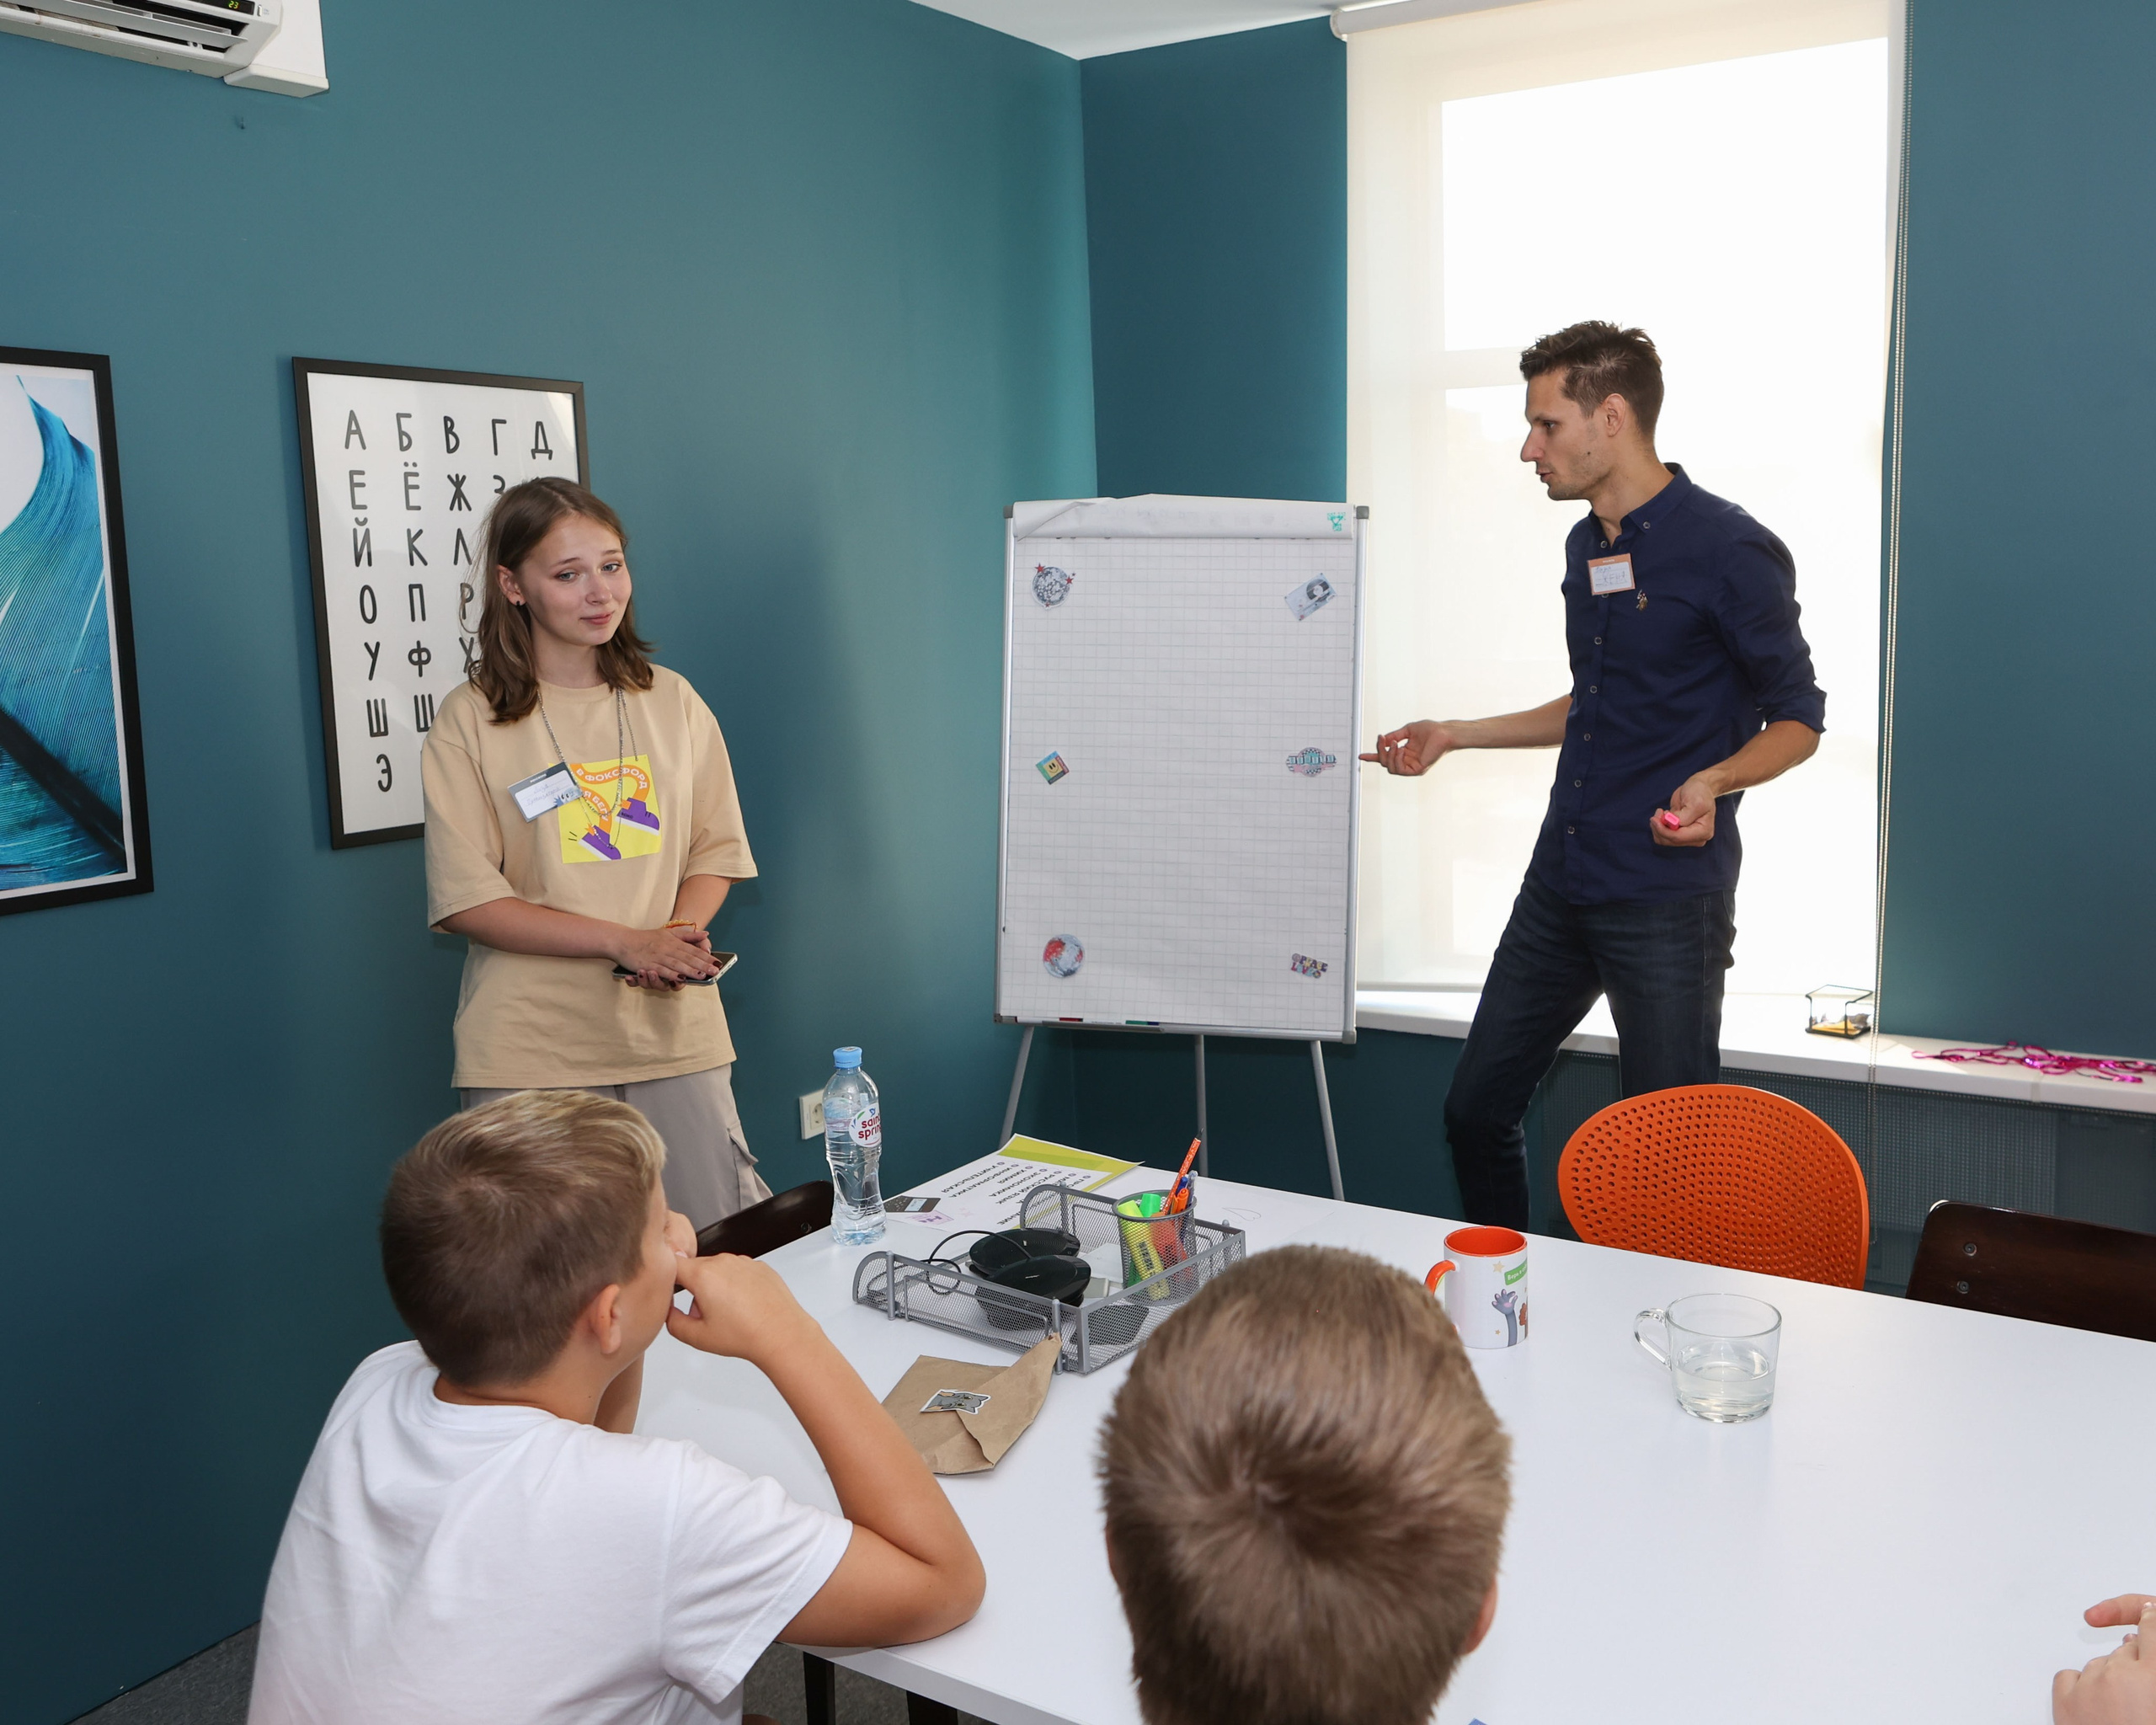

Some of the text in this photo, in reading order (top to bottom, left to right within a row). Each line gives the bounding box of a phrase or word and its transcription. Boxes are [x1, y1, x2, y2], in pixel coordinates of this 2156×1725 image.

[228, 0, 239, 8] 23
[344, 409, 553, 460] А Б В Г Д
[349, 470, 367, 510] Е
[403, 462, 421, 510] Ё
[447, 473, 472, 511] Ж
[353, 517, 472, 567] Й К Л
[359, 582, 474, 624] О П Р
[364, 637, 475, 681] У Ф Х
[366, 698, 388, 737] Ш
[376, 754, 392, 792] Э
[584, 767, 648, 789] ФОКСФОРД
[858, 1124, 882, 1140] sprin
[862, 1115, 881, 1129] sain
[941, 1165, 999, 1194] УЧИТЕЛЬСКАЯ
[948, 1167, 1012, 1198] ИНФОРМАТИКА
[988, 1172, 1041, 1198] ЭКОНОМИКА
[997, 1169, 1027, 1184] ХИМИЯ
[1019, 1174, 1055, 1194] РУССКИЙ
[995, 1191, 1021, 1205] ЯЗЫК
